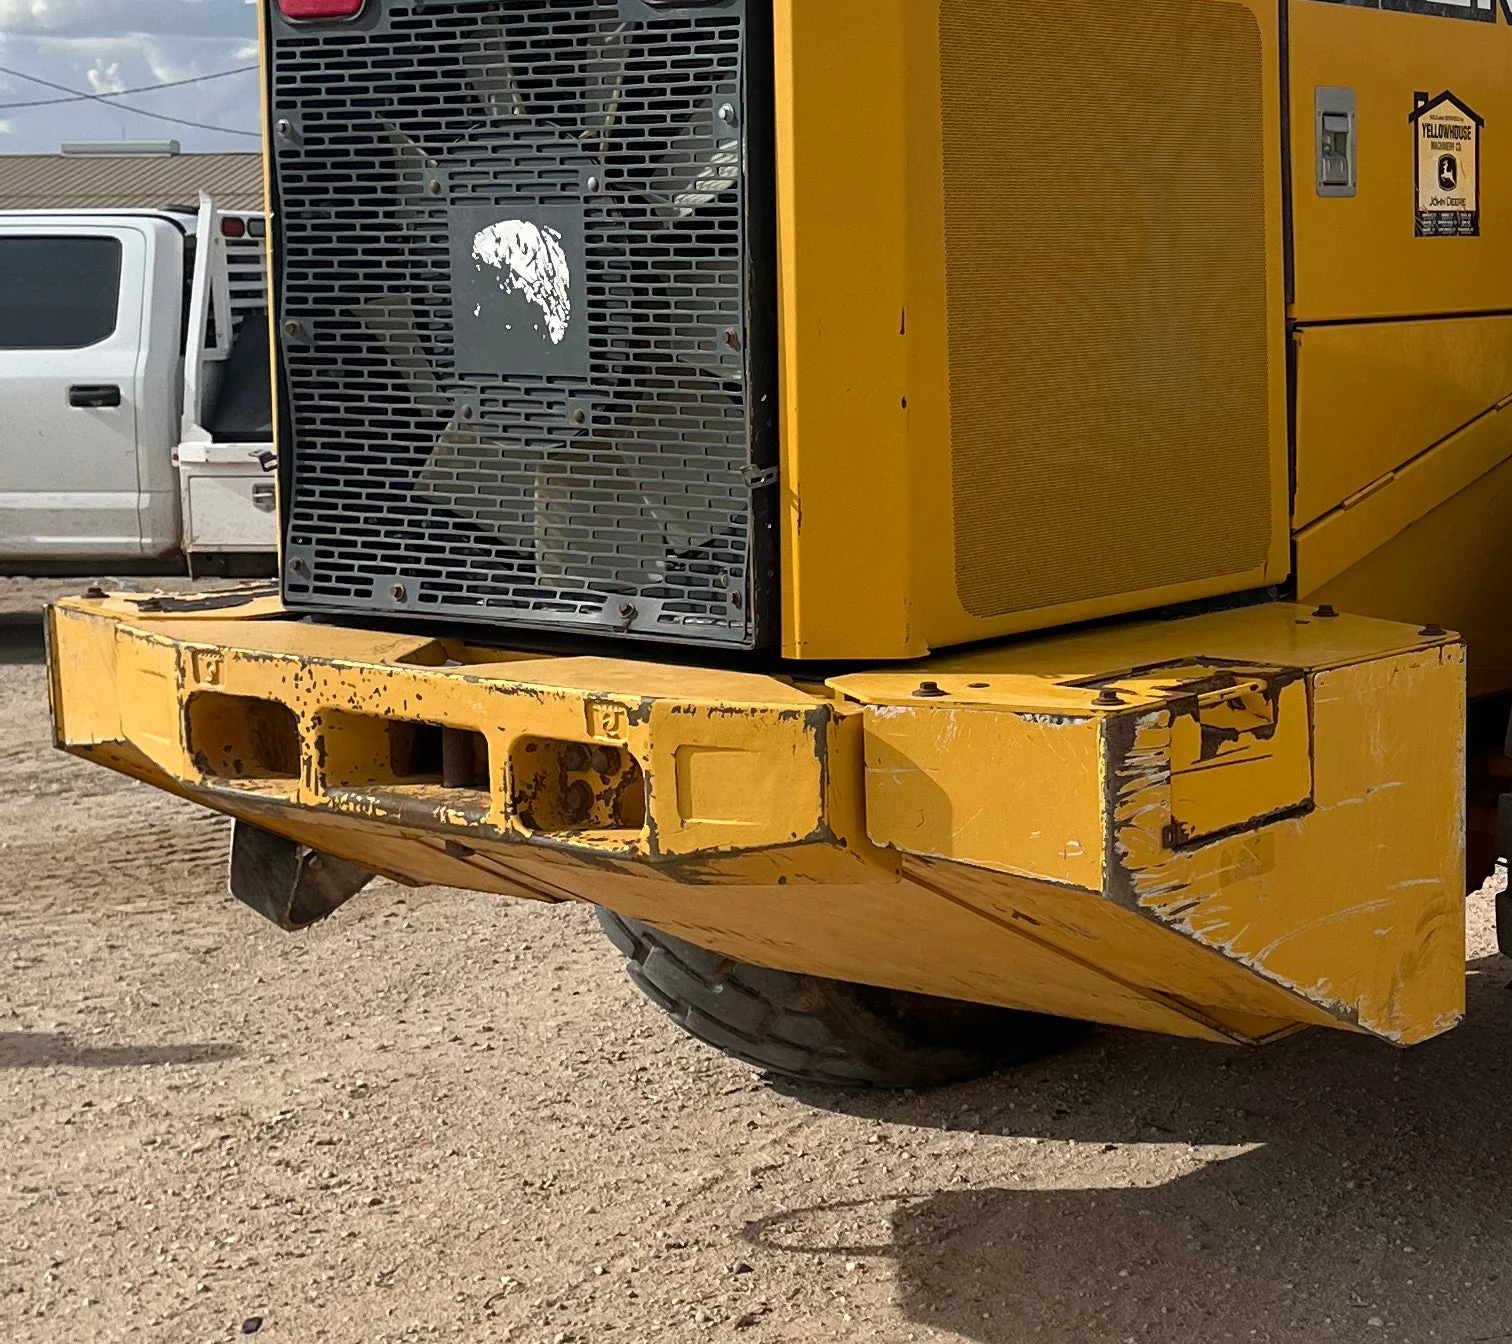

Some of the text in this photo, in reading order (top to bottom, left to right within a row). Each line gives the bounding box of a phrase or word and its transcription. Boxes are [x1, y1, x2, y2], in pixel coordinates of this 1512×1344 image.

[1422, 123, 1472, 140] YELLOWHOUSE
[1429, 196, 1466, 206] JOHN DEERE
